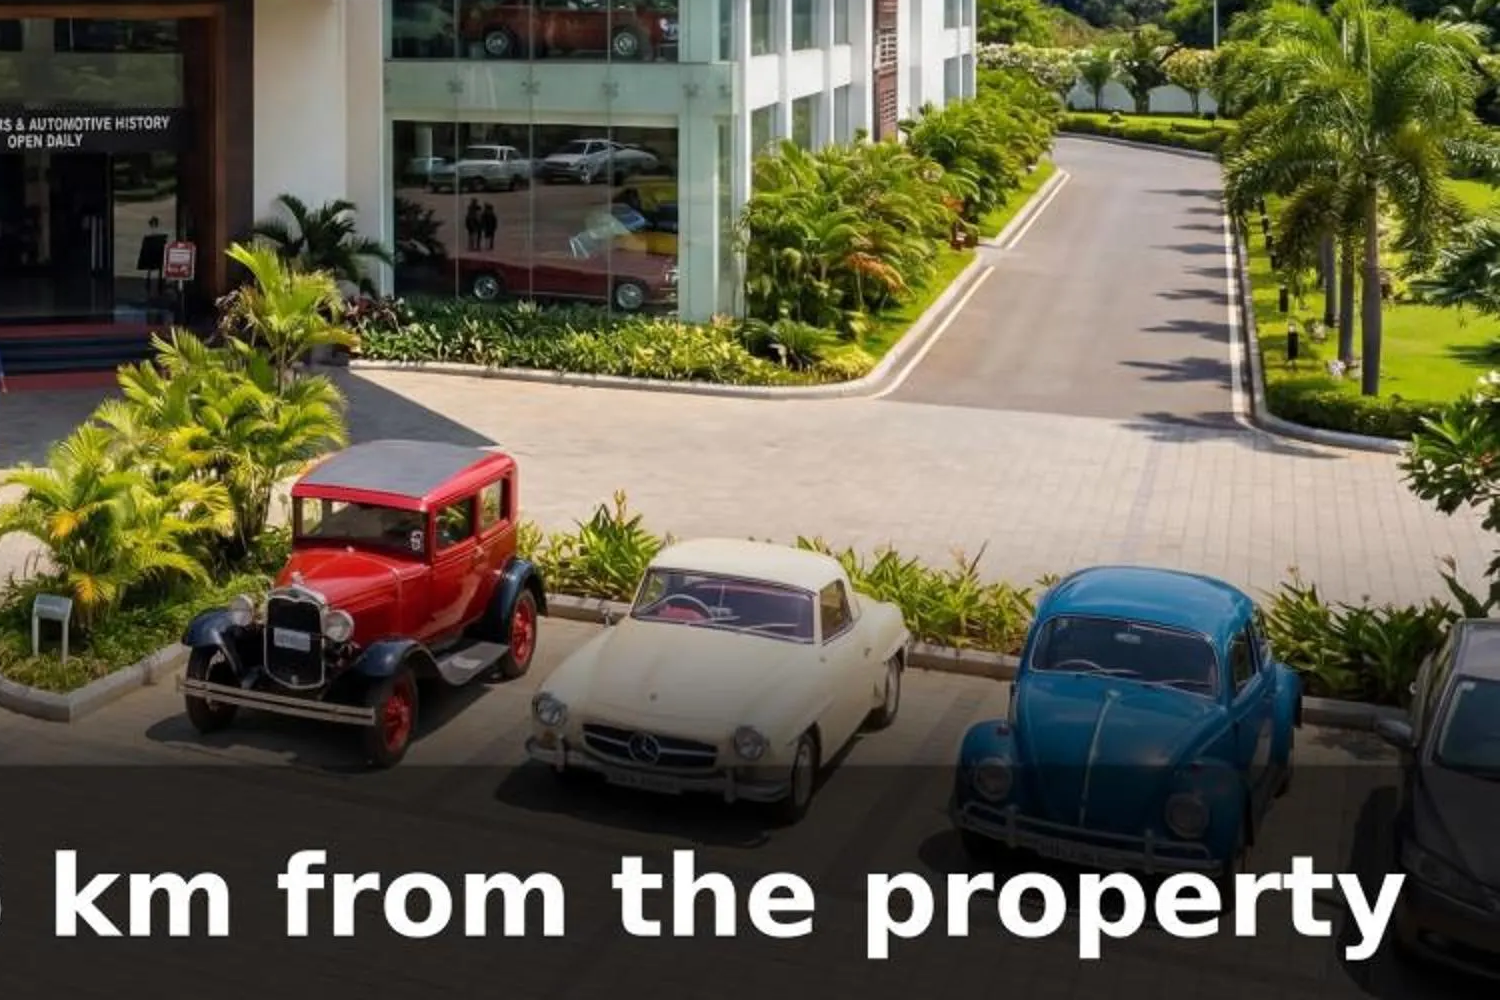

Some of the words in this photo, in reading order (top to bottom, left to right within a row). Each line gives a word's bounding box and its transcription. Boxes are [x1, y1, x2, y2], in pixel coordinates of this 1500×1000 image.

[16, 117, 25, 132] &
[29, 116, 112, 132] AUTOMOTIVE
[115, 115, 170, 131] HISTORY
[7, 133, 43, 149] OPEN
[47, 133, 83, 148] DAILY
